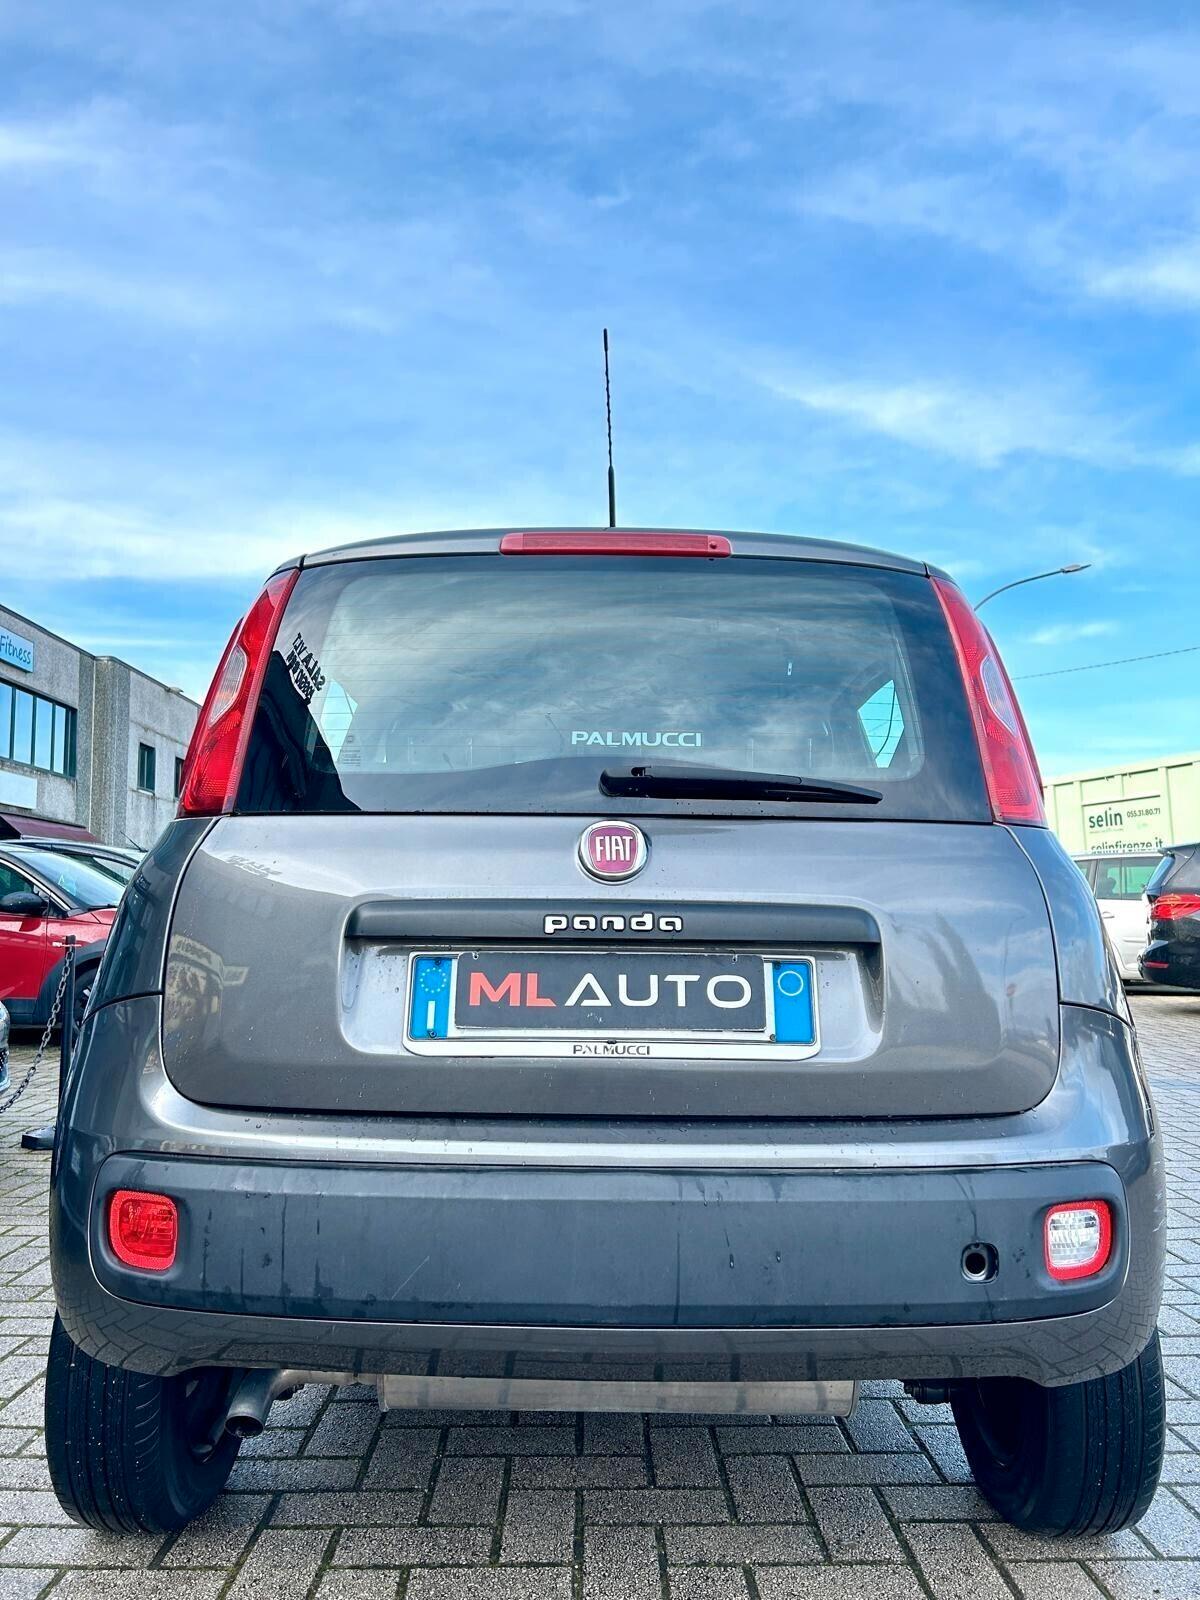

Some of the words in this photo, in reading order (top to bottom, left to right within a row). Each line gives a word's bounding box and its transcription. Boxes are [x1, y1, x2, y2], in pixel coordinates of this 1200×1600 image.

[0, 635, 31, 664] Fitness
[571, 731, 702, 747] PALMUCCI
[1089, 807, 1123, 828] selin
[595, 835, 634, 862] FIAT
[1091, 837, 1163, 851] selinfirenzeit
[543, 912, 684, 935] panda
[573, 1044, 651, 1055] PALMUCCI
